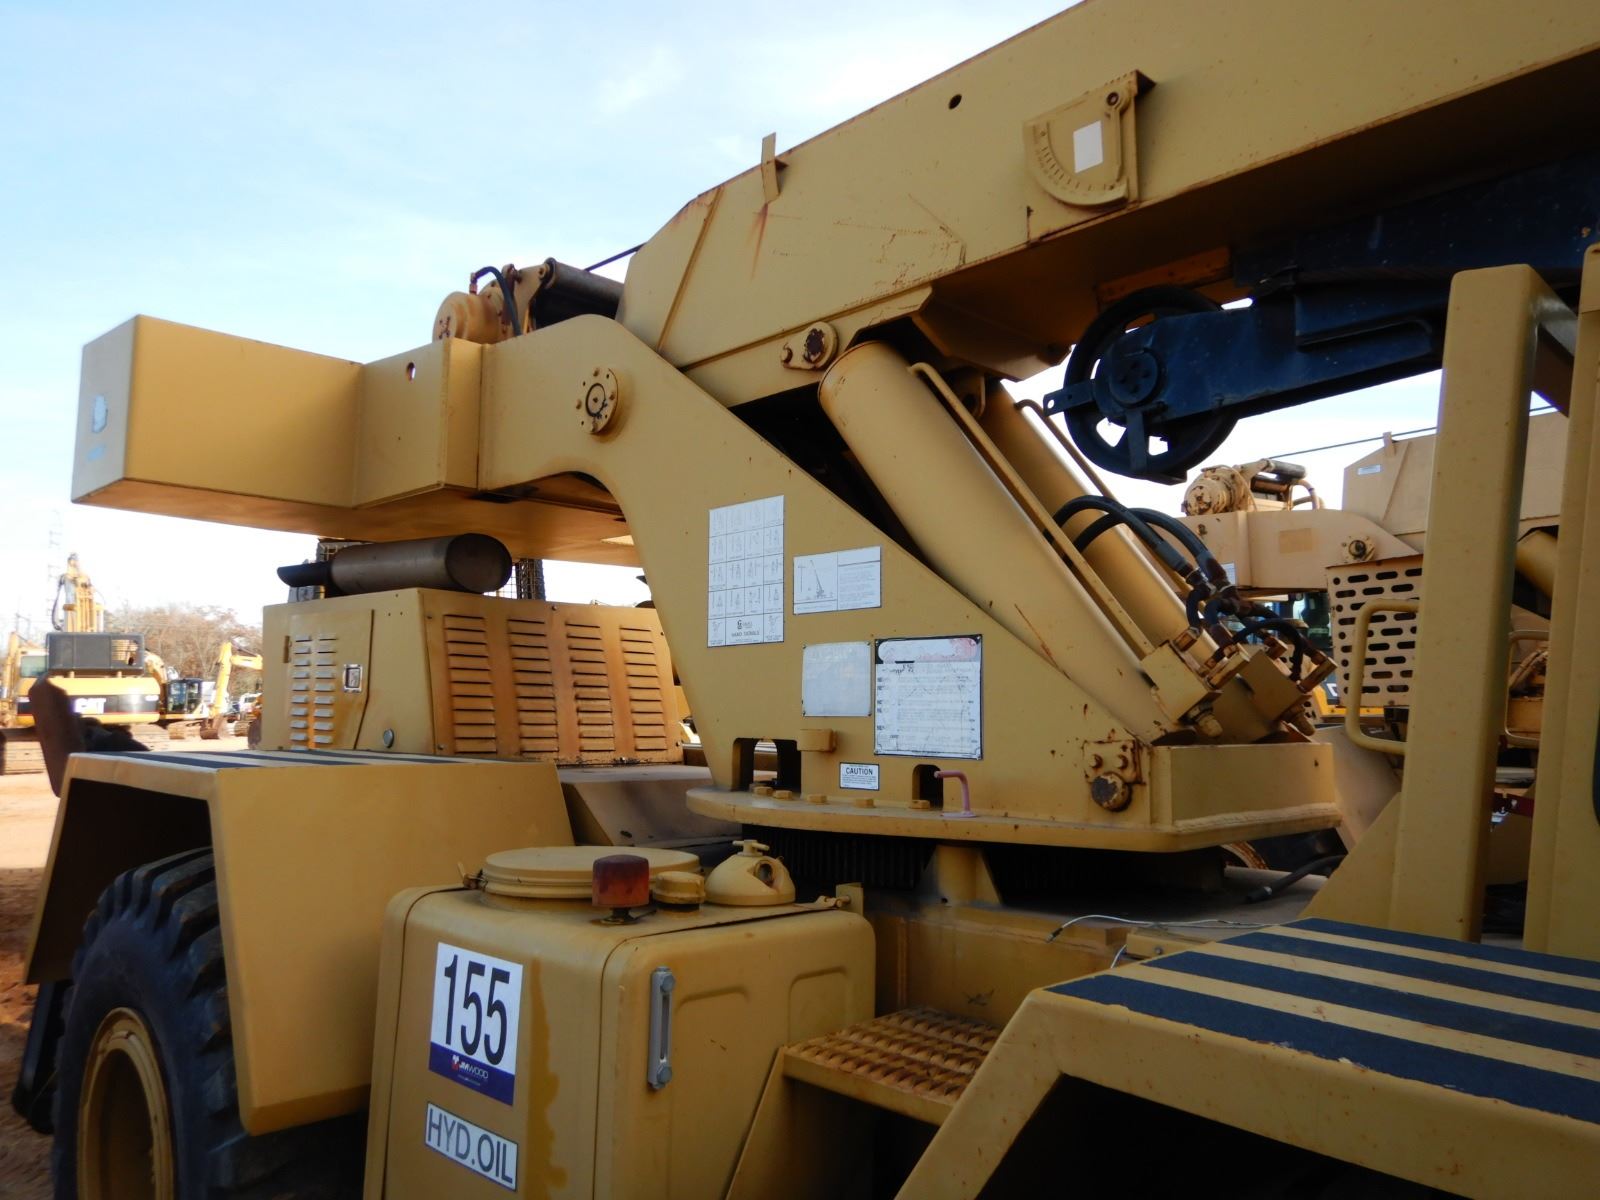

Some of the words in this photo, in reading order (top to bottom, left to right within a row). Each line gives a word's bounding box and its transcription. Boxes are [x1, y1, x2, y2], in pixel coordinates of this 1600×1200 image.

[845, 767, 873, 775] CAUTION
[444, 954, 510, 1066] 155
[428, 1108, 513, 1184] HYD.OIL
